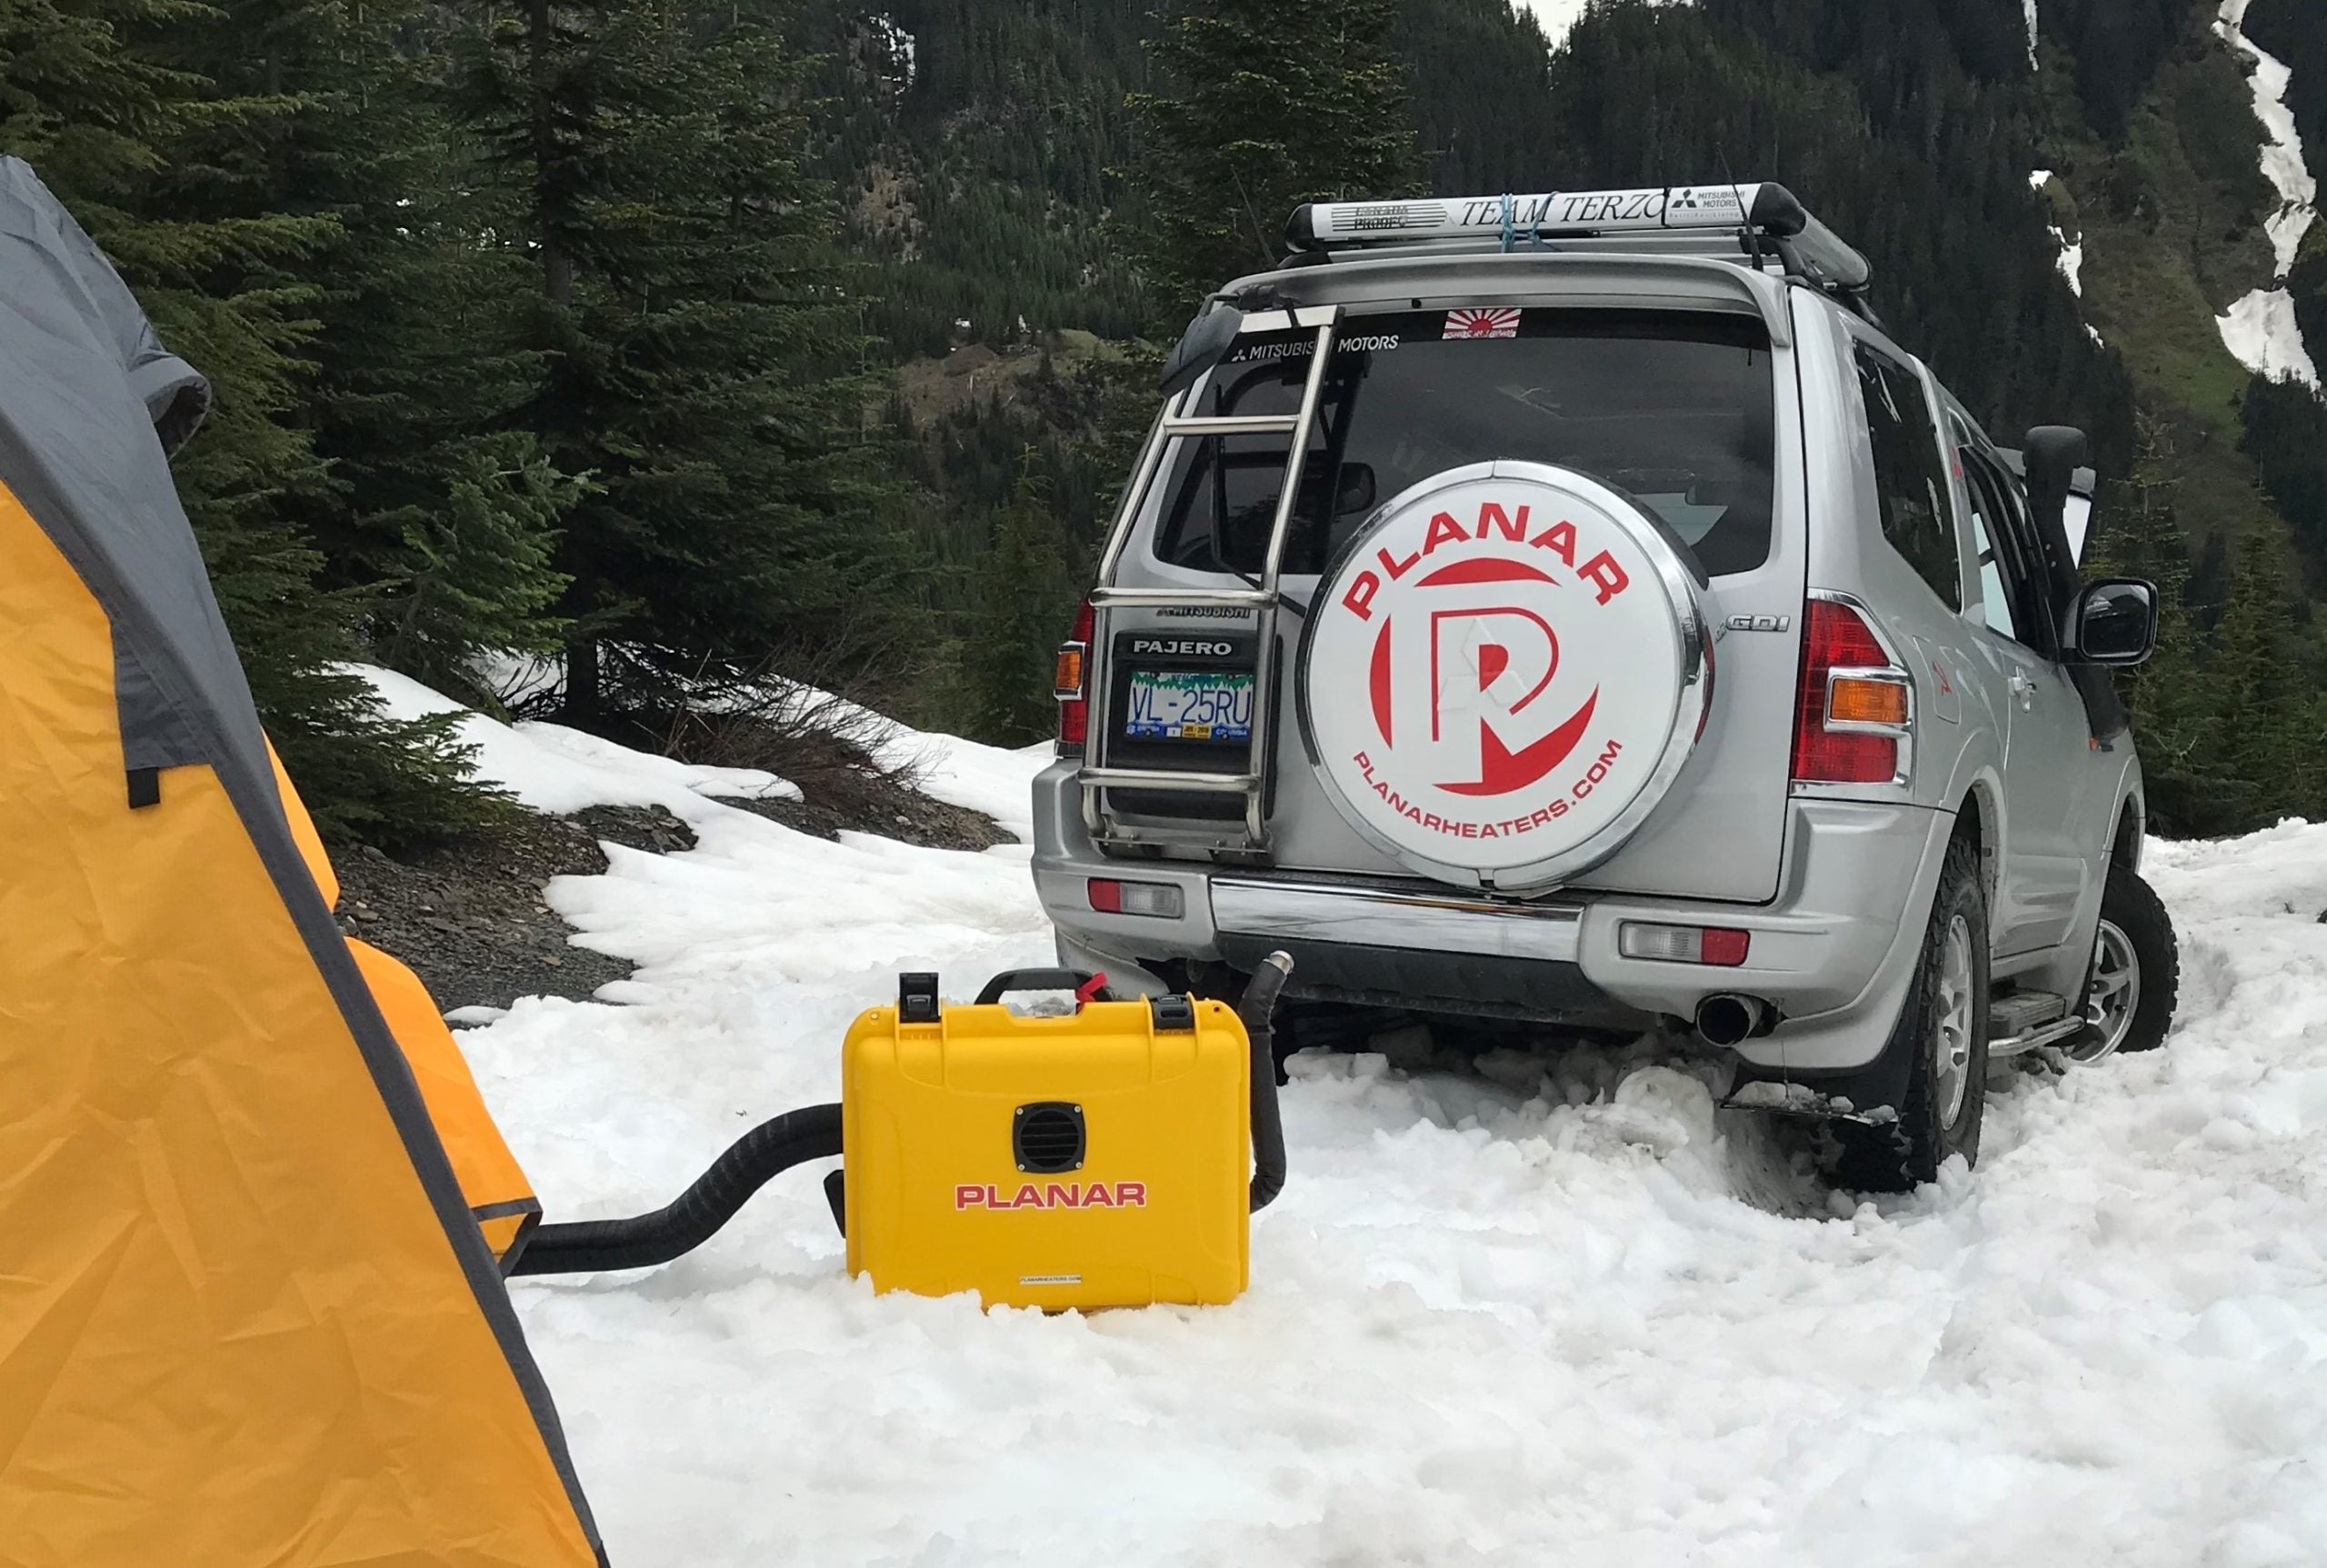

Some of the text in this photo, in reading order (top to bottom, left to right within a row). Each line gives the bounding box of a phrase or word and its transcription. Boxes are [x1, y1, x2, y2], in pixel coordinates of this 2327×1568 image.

[1560, 193, 1665, 223] TERZO
[1703, 199, 1737, 208] MOTORS
[1249, 335, 1400, 361] MITSUBIS MOTORS
[1342, 502, 1630, 621] PLANAR
[1726, 614, 1790, 632] GDI
[1134, 640, 1233, 655] PAJERO
[1353, 739, 1623, 838] PLANARHEATERS.COM
[956, 1182, 1146, 1211] PLANAR
